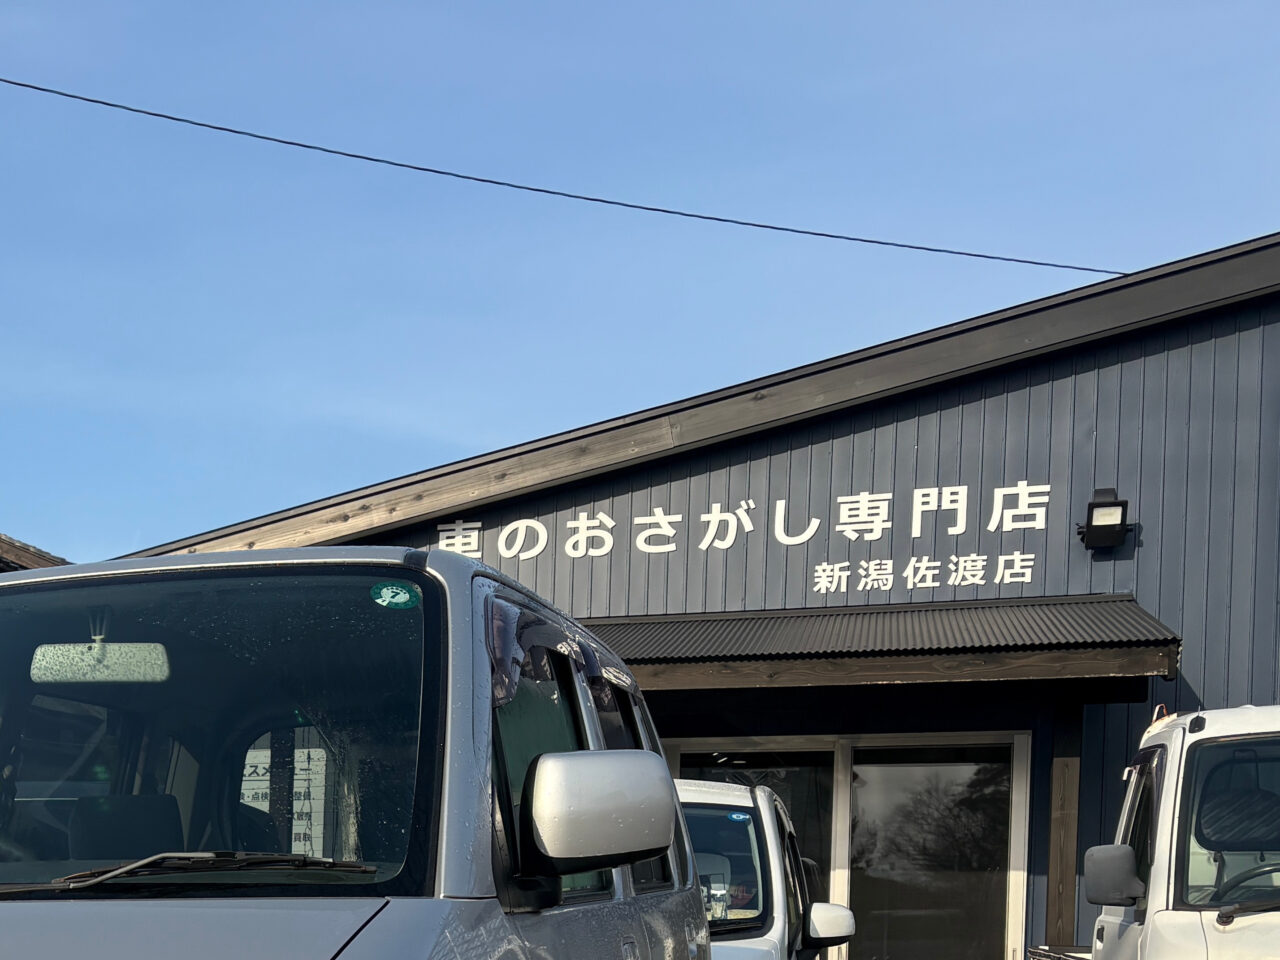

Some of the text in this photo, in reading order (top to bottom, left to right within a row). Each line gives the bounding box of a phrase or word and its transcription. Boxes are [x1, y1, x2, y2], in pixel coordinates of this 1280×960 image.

[437, 481, 1052, 561] 車のおさがし専門店
[814, 551, 1036, 594] 新潟佐渡店
